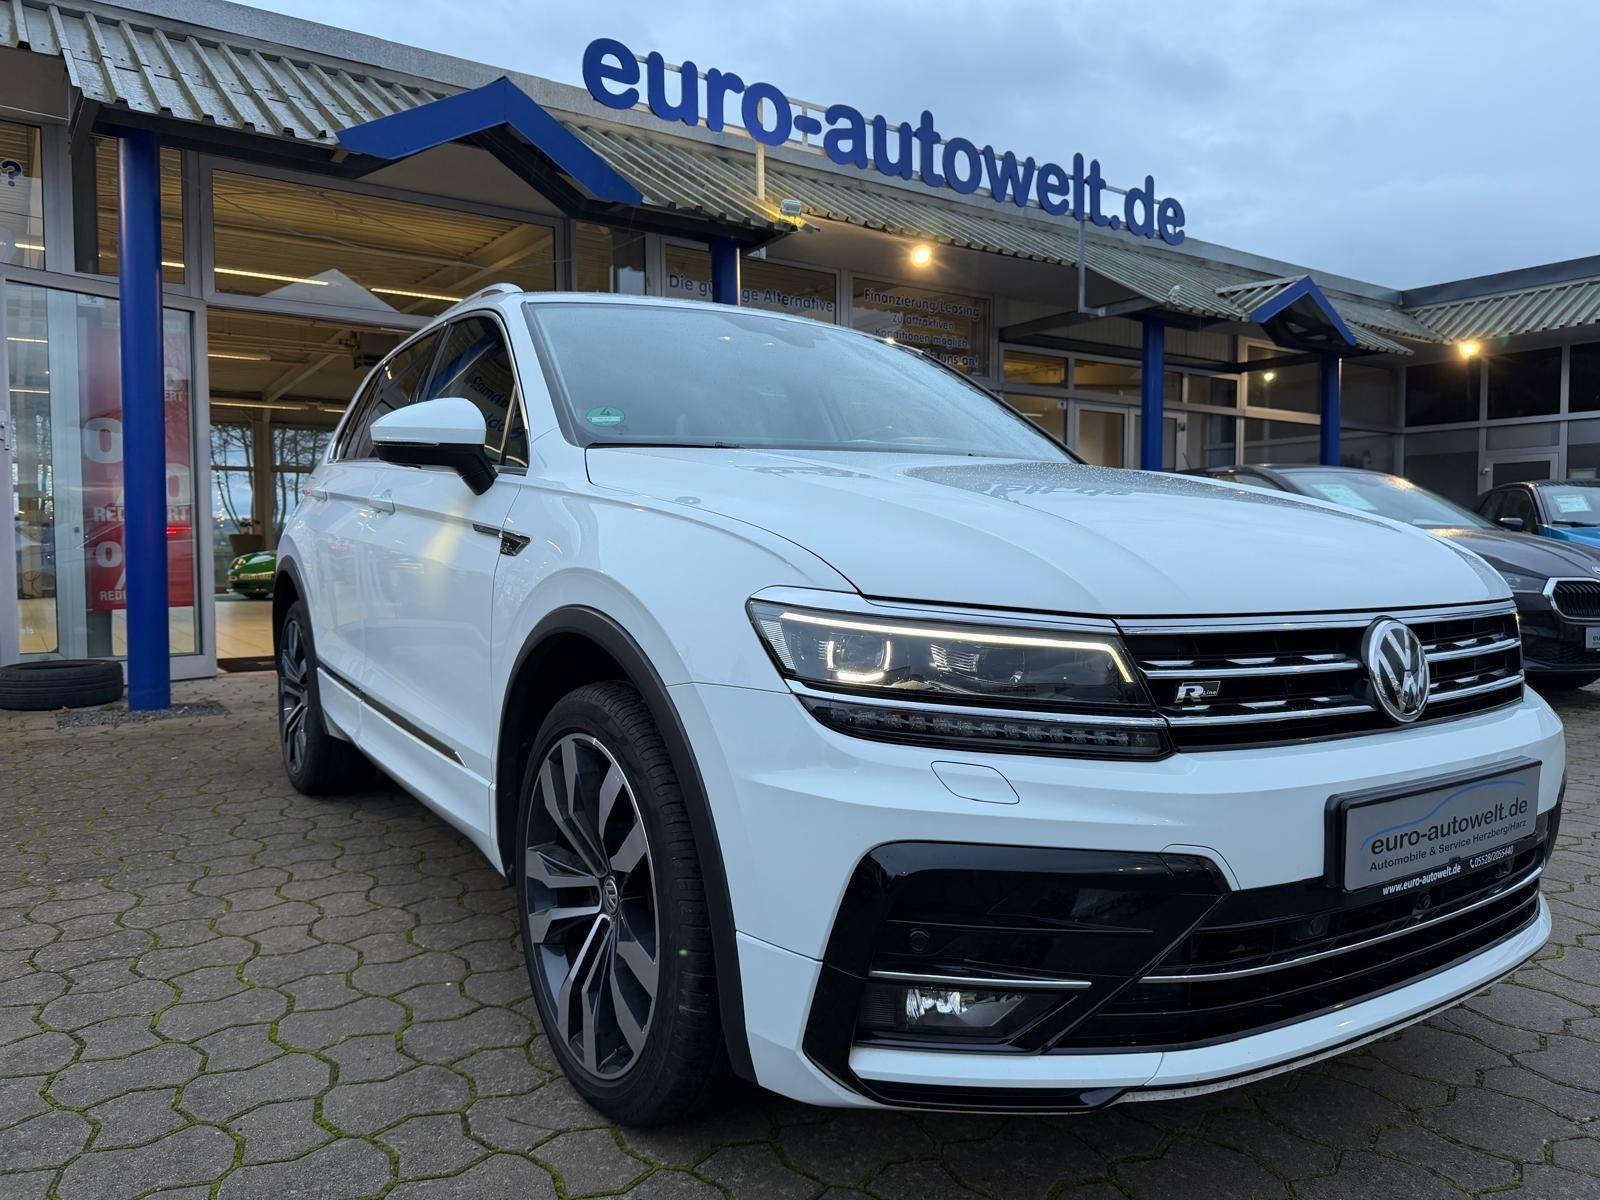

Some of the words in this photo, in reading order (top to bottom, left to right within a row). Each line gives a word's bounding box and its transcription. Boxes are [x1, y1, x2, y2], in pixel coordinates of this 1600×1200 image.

[582, 37, 1186, 246] euro-autowelt.de
[669, 274, 694, 290] Die
[763, 289, 834, 313] Alternative
[1369, 850, 1427, 873] Automobile
[1429, 846, 1437, 856] &
[1438, 837, 1471, 854] Service
[1473, 819, 1527, 843] Herzberg/Harz
[1371, 797, 1528, 855] euro-autowelt.de
[1382, 863, 1461, 896] www.euro-autowelt.de
